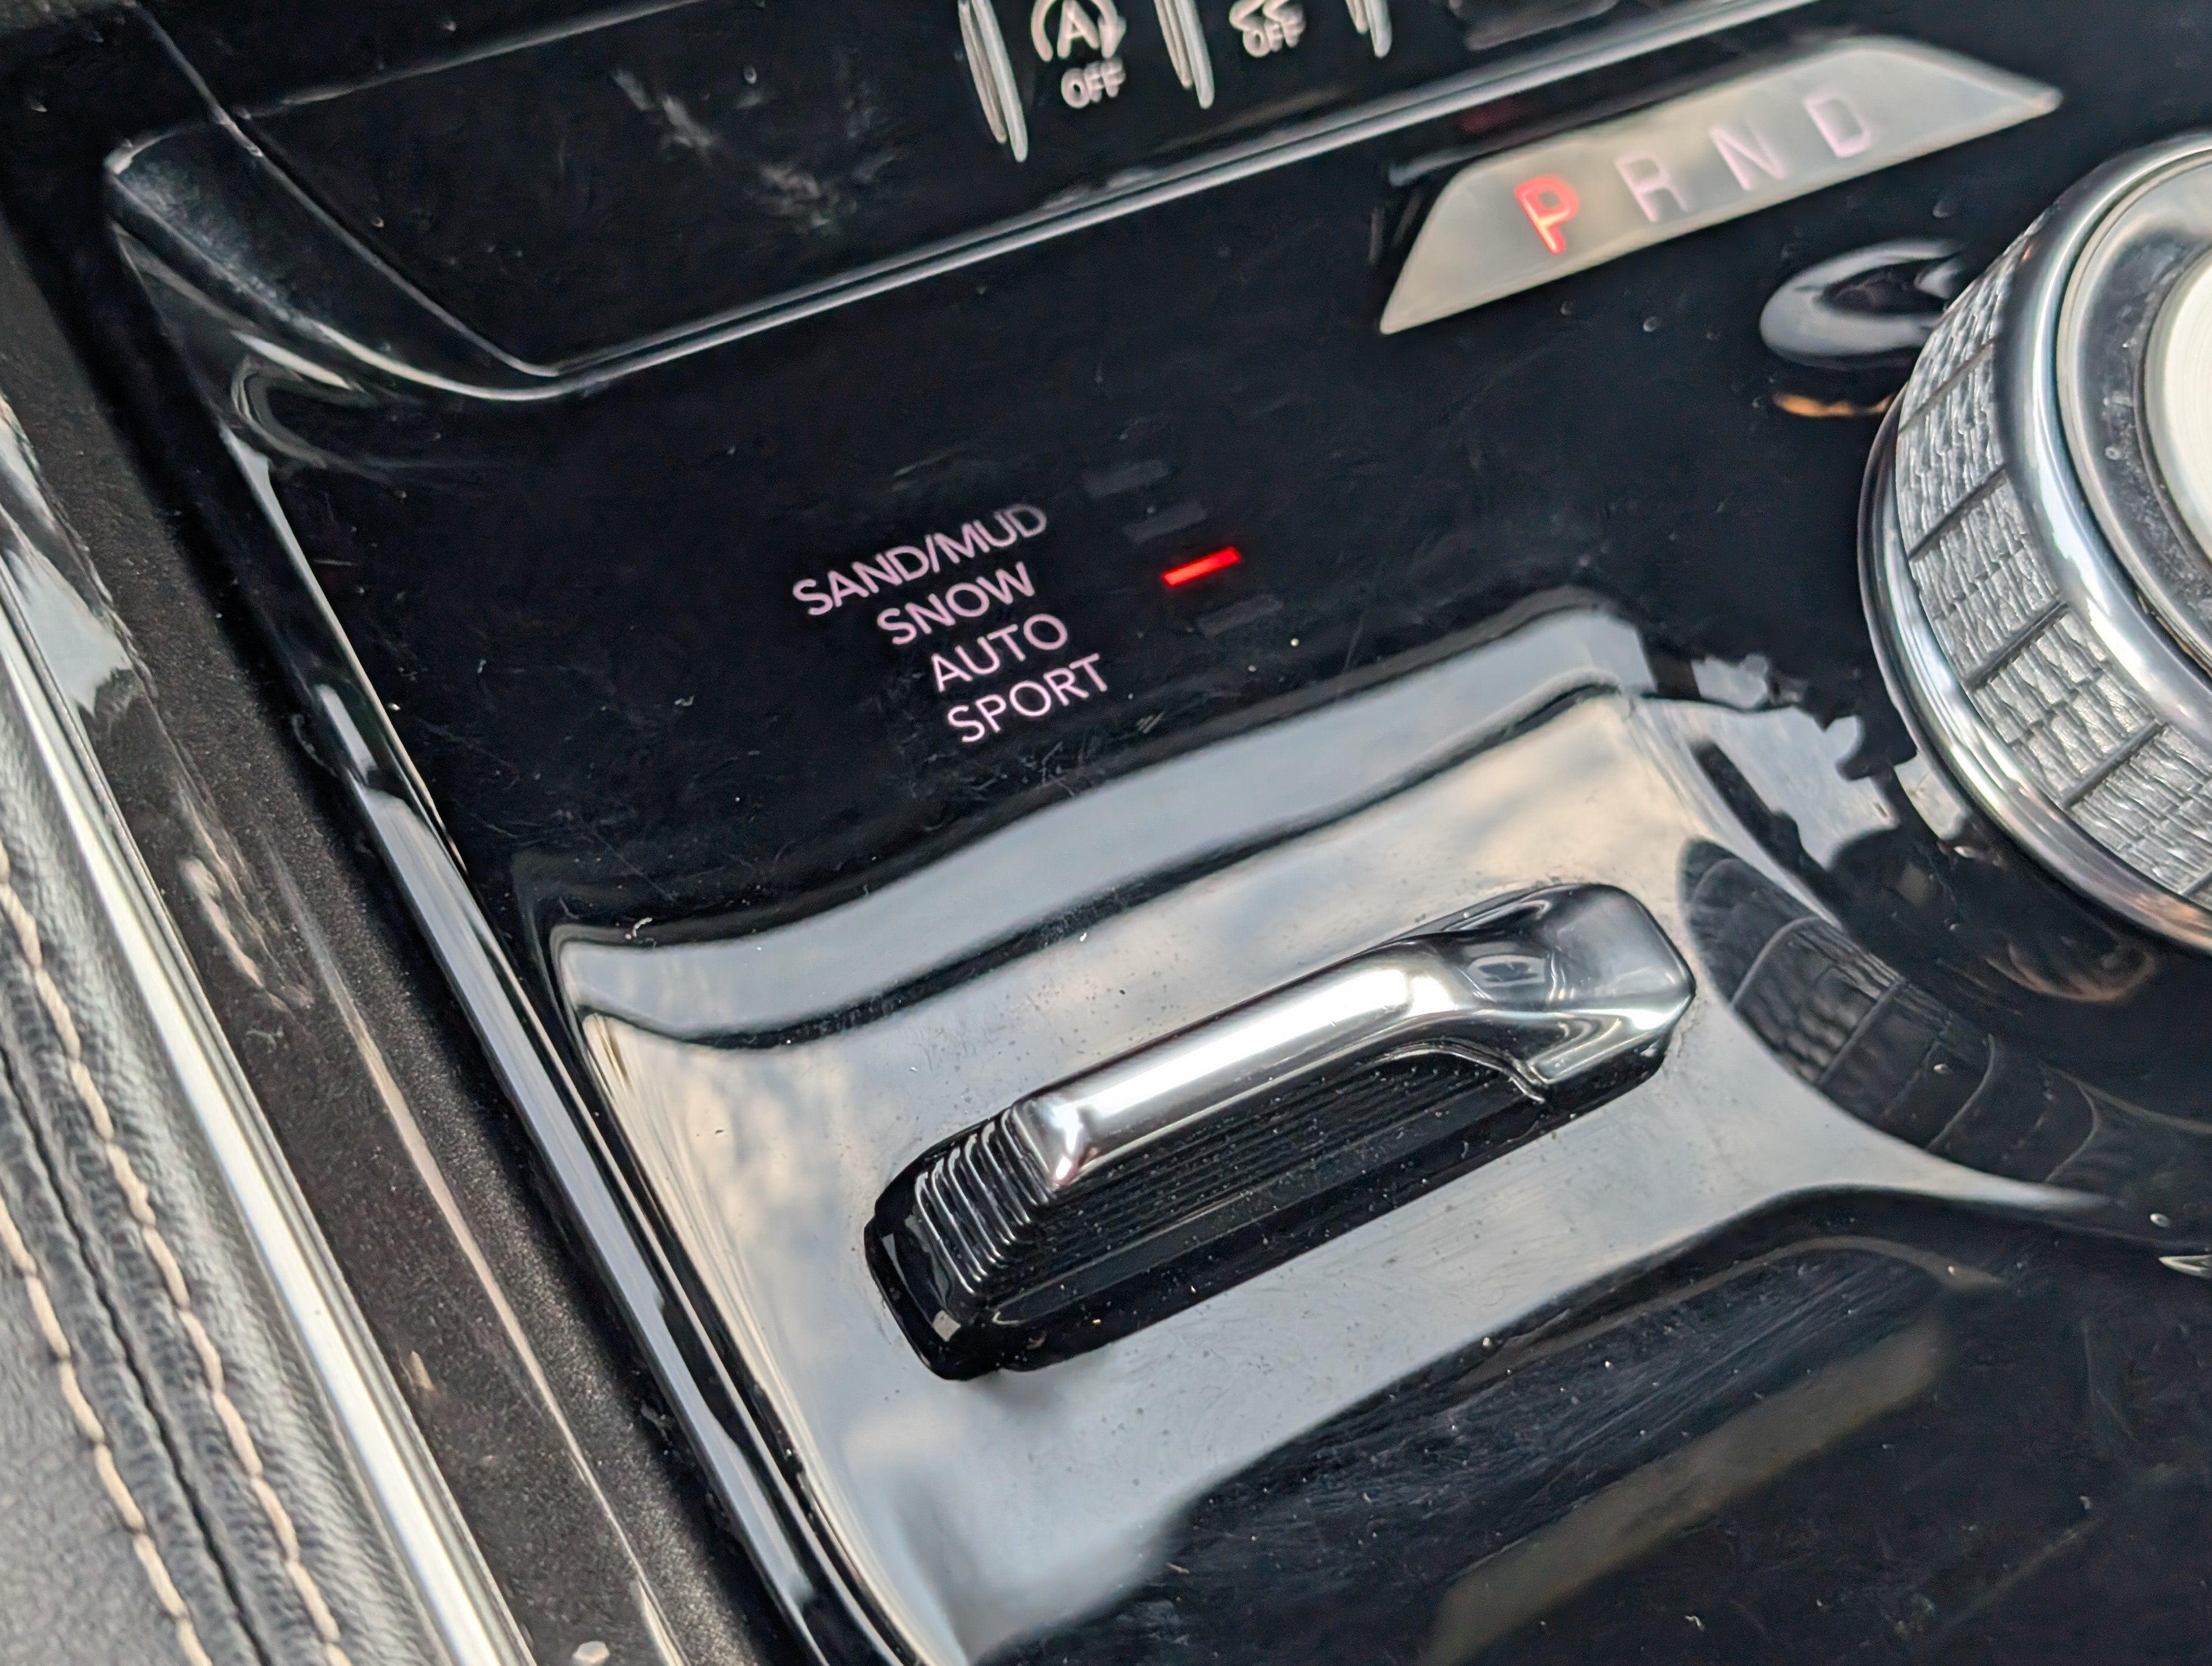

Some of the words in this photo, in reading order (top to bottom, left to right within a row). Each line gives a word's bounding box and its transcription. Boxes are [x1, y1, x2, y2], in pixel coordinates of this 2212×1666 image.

[1243, 8, 1306, 58] OFF
[1061, 57, 1126, 108] OFF
[1514, 175, 1580, 254] P
[1615, 150, 1689, 222] R
[1709, 118, 1786, 191] N
[1803, 87, 1873, 157] D
[792, 504, 1047, 615] SAND/MUD
[877, 561, 1036, 645] SNOW
[931, 613, 1068, 693] AUTO
[947, 653, 1108, 743] SPORT
